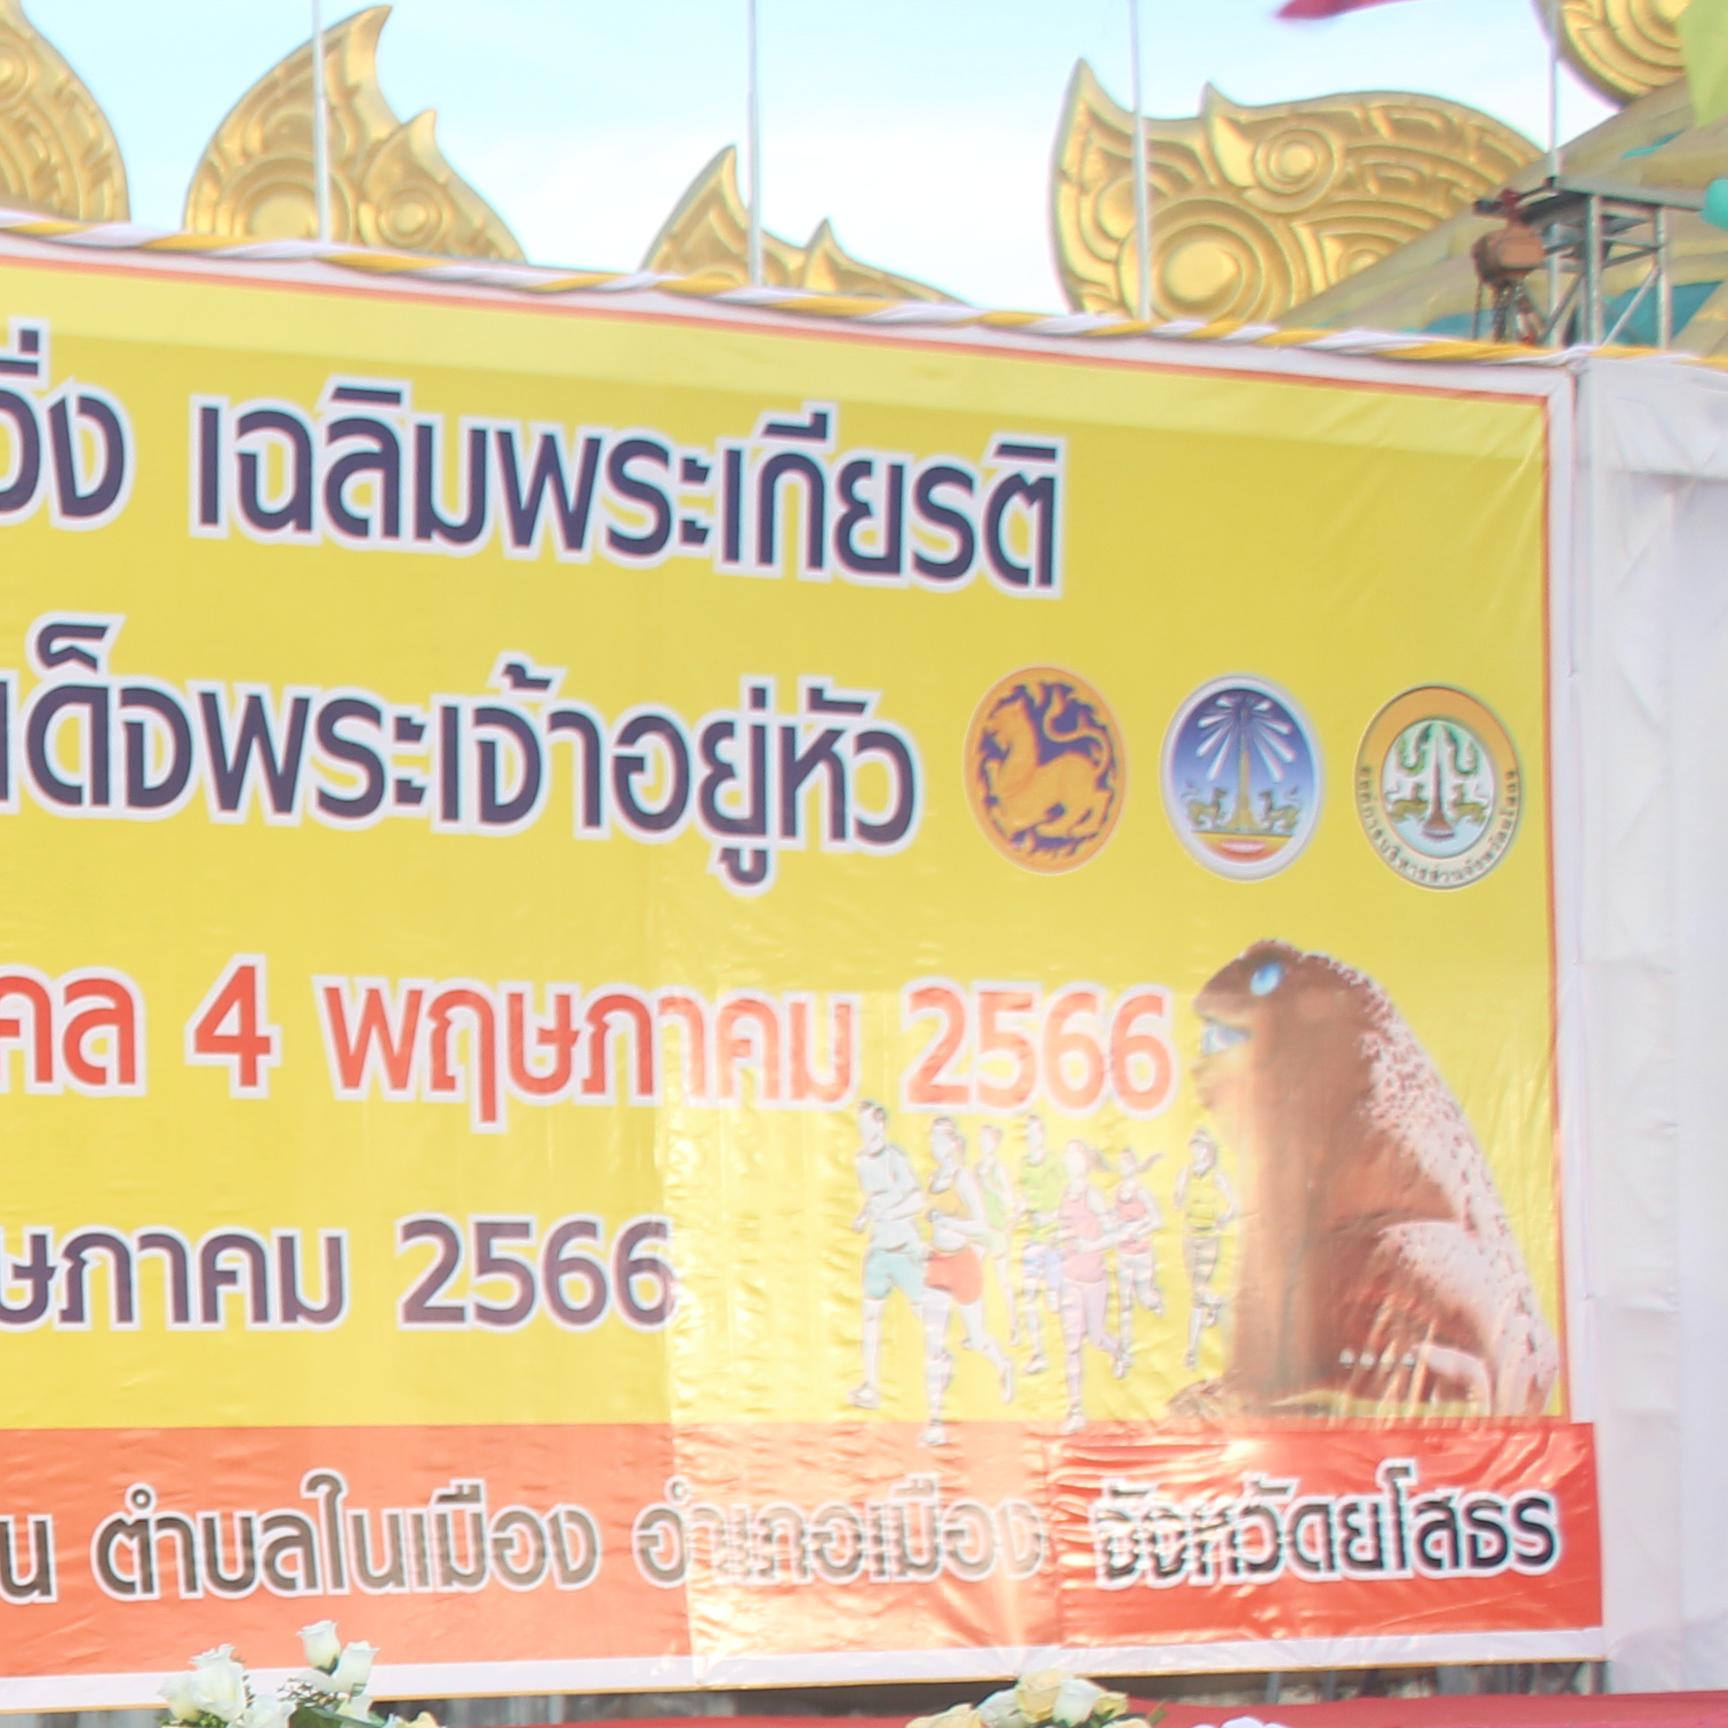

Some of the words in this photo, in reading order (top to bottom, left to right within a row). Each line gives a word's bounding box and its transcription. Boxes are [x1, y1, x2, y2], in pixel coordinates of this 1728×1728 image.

[189, 375, 1066, 597] เฉลิมพระเกียรติ
[189, 960, 278, 1095] 4
[319, 975, 854, 1132] พฤษภาคม
[904, 983, 1176, 1115] 2566
[394, 1216, 678, 1327] 2566
[92, 1472, 598, 1598] ตำบลในเมือง
[632, 1475, 1048, 1590] อำเภอเมือง
[1090, 1458, 1564, 1590] จังหวัดยโสธร
